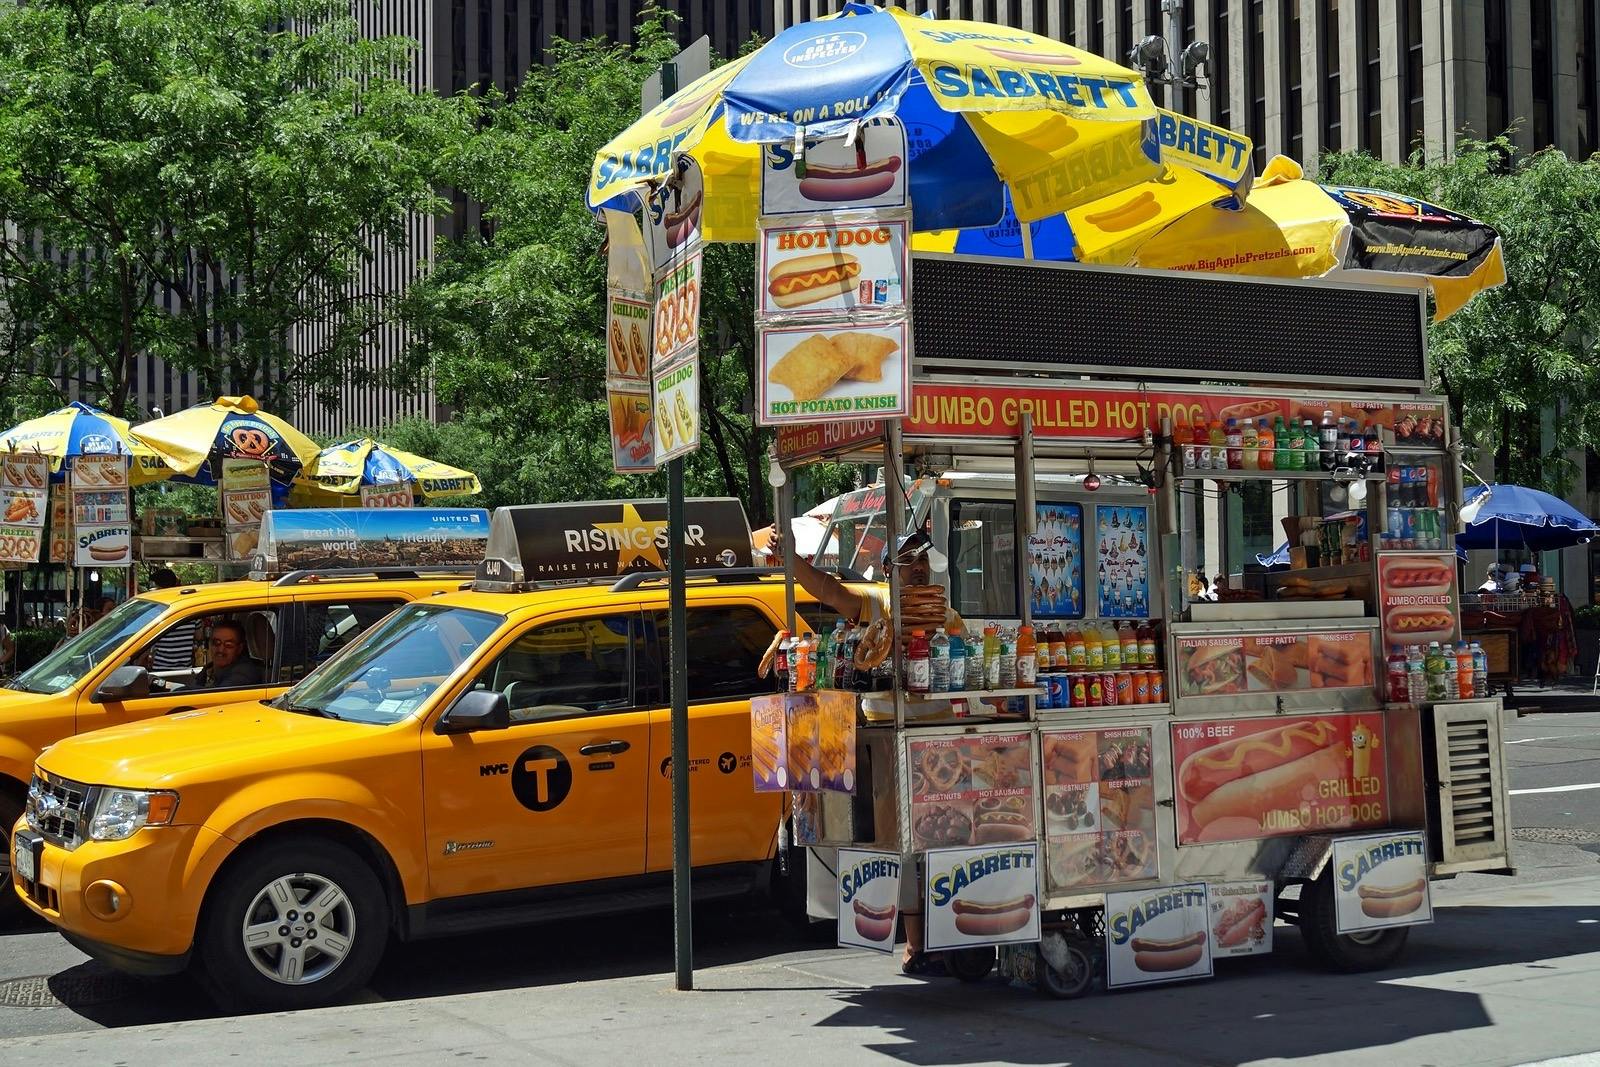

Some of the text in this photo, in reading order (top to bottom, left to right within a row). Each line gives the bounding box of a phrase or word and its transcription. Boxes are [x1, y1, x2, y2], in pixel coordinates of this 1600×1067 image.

[930, 60, 1138, 108] SABRETT
[740, 111, 788, 126] WE'RE
[793, 107, 815, 124] ON
[819, 104, 829, 119] A
[834, 95, 871, 117] ROLL
[1160, 112, 1247, 171] BRETT
[777, 226, 892, 250] HOT DOG
[1365, 242, 1468, 261] www.BigApplePretzels.com
[612, 302, 649, 320] CHILI DOG
[657, 364, 693, 393] CHILI DOG
[770, 395, 897, 414] HOT POTATO KNISH
[910, 395, 1204, 428] JUMBO GRILLED HOT DOG
[1366, 402, 1384, 410] PATTY
[1417, 403, 1436, 411] KEBAB
[825, 422, 846, 444] HOT
[851, 420, 876, 438] DOG
[780, 430, 819, 453] GRILLED
[423, 477, 475, 492] SABRETT
[79, 528, 128, 549] SABRETT
[303, 527, 335, 540] great
[402, 532, 448, 544] friendly
[564, 527, 651, 553] RISING
[322, 540, 357, 551] world
[486, 562, 501, 576] 8J40
[538, 563, 577, 572] RAISE
[585, 562, 608, 570] THE
[617, 559, 649, 568] WALL
[1386, 595, 1452, 606] JUMBO GRILLED
[1180, 638, 1243, 648] ITALIAN SAUSAGE
[1256, 636, 1297, 646] BEEF PATTY
[980, 735, 1018, 745] BEEF PATTY
[1104, 730, 1142, 739] SHISH KEBAB
[1177, 725, 1235, 739] 100% BEEF
[925, 741, 954, 749] PRETZEL
[480, 758, 558, 803] NYC T
[1108, 779, 1142, 789] BEEF PATTY
[1318, 776, 1380, 799] GRILLED
[923, 792, 961, 801] CHESTNUTS
[994, 788, 1025, 797] SAUSAGE
[1259, 803, 1383, 832] JUMBO HOT DOG
[1339, 836, 1424, 892] SABRETT
[840, 856, 900, 904] SABRETT
[930, 850, 1035, 907] SABRETT
[1110, 887, 1205, 945] SABRETT
